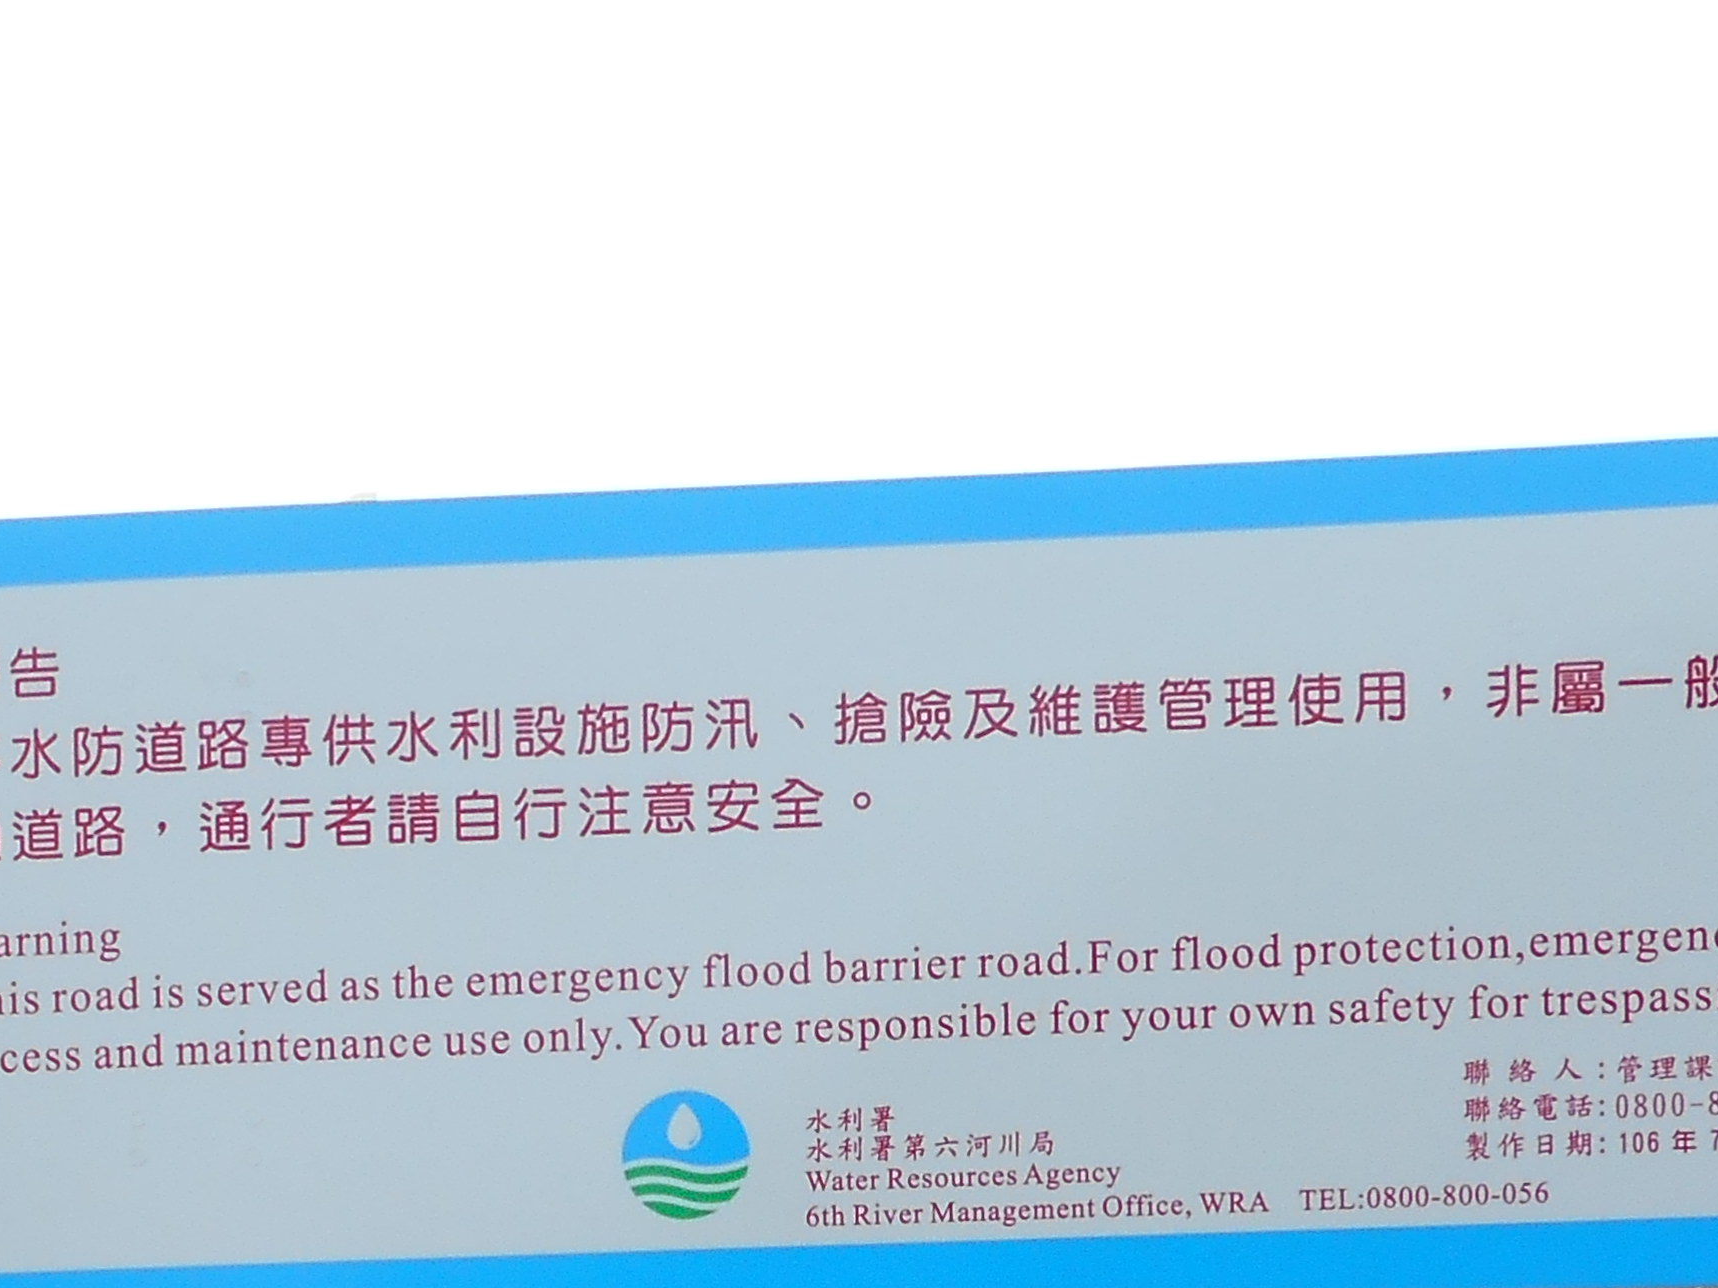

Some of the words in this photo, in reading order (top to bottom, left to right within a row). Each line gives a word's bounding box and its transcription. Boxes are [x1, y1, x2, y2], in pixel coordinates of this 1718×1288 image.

[51, 975, 140, 1014] road
[152, 973, 184, 1009] is
[196, 967, 329, 1008] served
[340, 976, 380, 1002] as
[391, 963, 454, 1000] the
[465, 965, 690, 1004] emergency
[702, 949, 812, 989] flood
[822, 945, 967, 985] barrier
[1171, 932, 1283, 972] flood
[94, 1032, 164, 1070] and
[175, 1028, 432, 1067] maintenance
[443, 1030, 511, 1057] use
[721, 1020, 783, 1047] are
[794, 1001, 1037, 1052] responsible
[1048, 999, 1111, 1035] for
[1120, 1004, 1218, 1043] your
[1229, 1000, 1316, 1029] own
[1328, 986, 1456, 1031] safety
[1468, 983, 1530, 1020] for
[805, 1105, 896, 1135] 水利署
[806, 1130, 1054, 1164] 水利署第六河川局
[804, 1169, 881, 1193] Water
[886, 1167, 1018, 1190] Resources
[1022, 1162, 1122, 1191] Agency
[805, 1204, 846, 1228] 6th
[852, 1202, 924, 1226] River
[929, 1198, 1096, 1228] Management
[1102, 1193, 1192, 1220] Office,
[1198, 1190, 1270, 1215] WRA
[1298, 1180, 1550, 1212] TEL:0800-800-056
